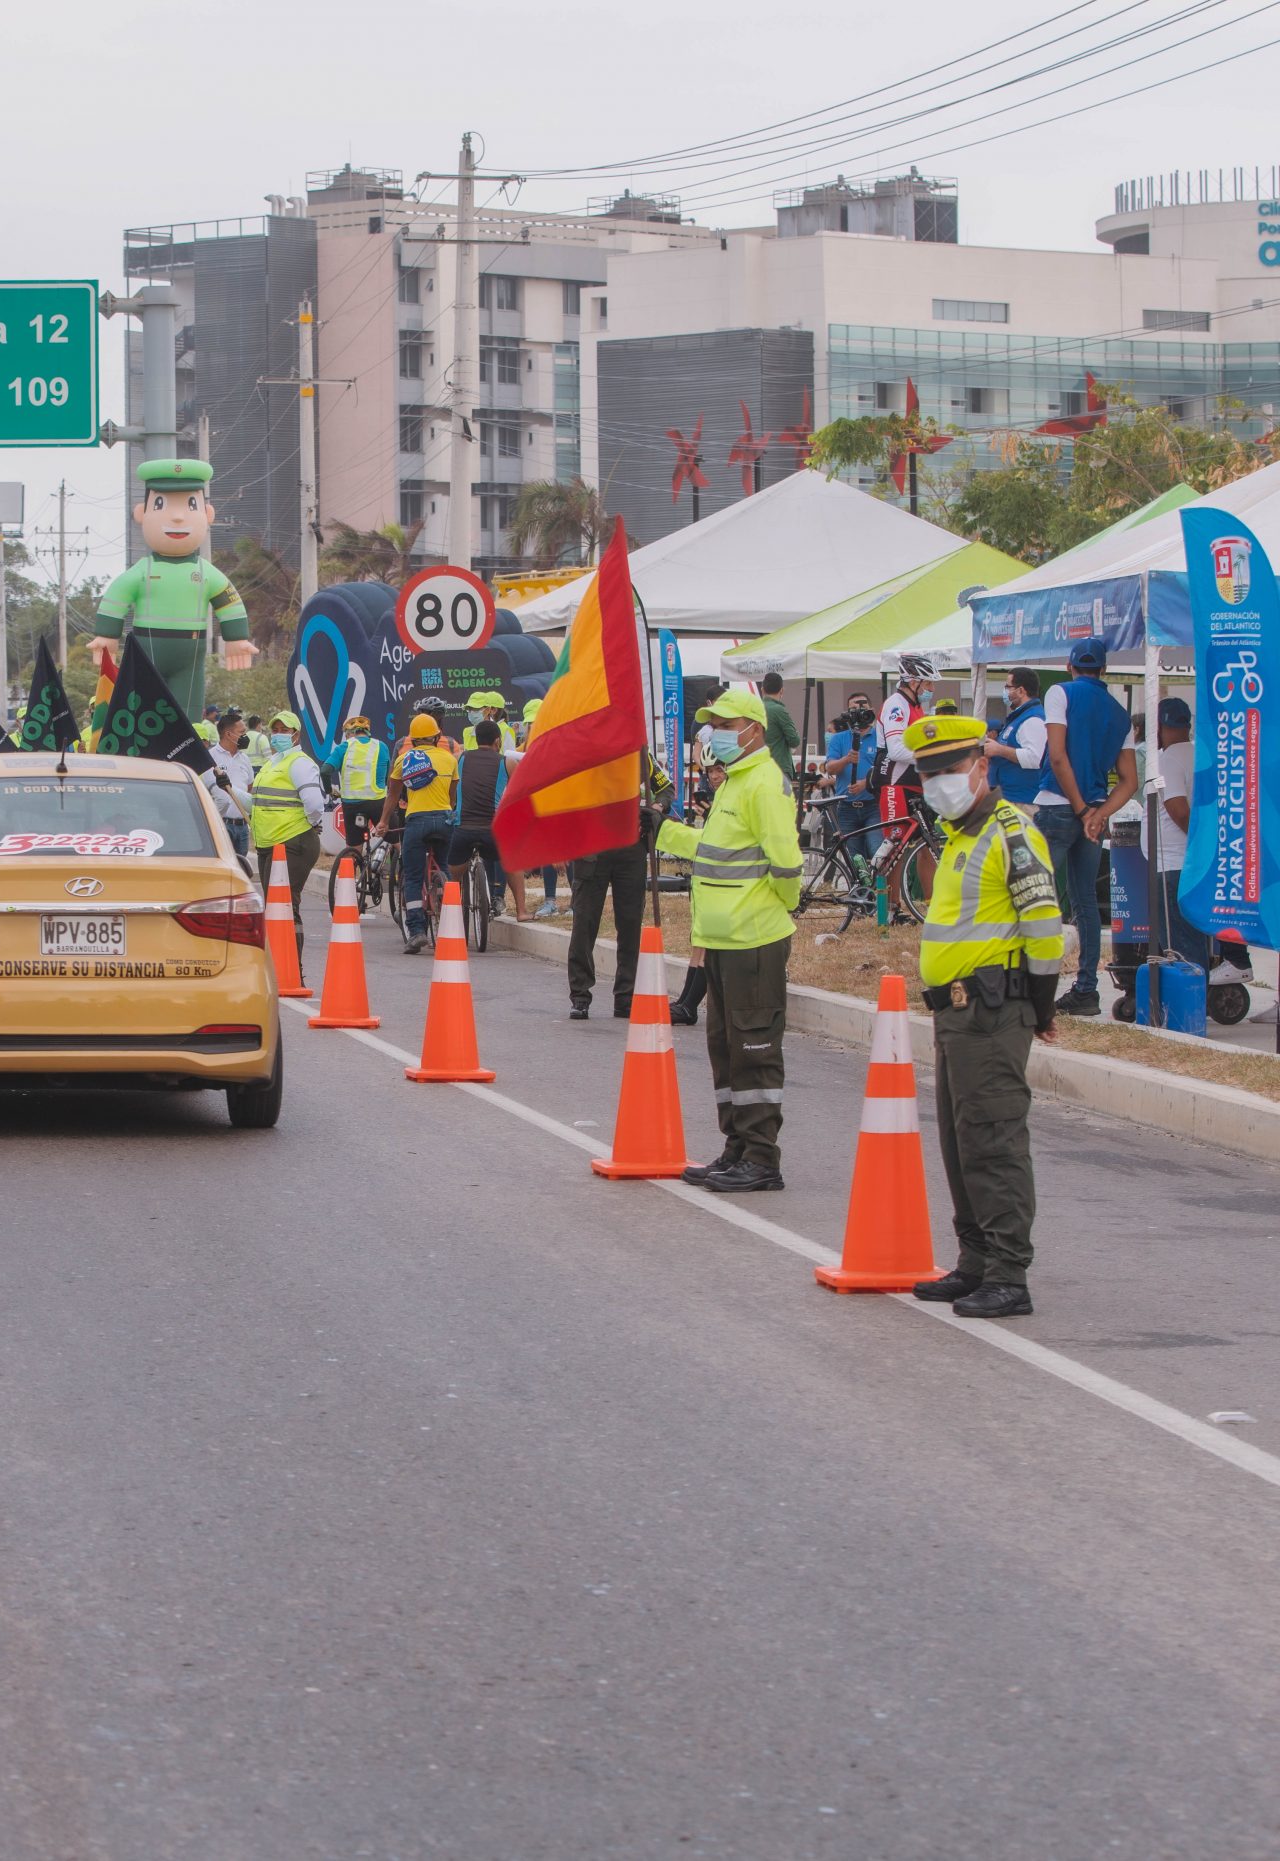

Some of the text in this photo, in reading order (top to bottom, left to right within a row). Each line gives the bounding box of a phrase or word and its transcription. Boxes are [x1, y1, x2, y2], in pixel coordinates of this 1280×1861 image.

[28, 314, 69, 344] 12
[7, 376, 69, 407] 109
[415, 593, 478, 637] 80
[1210, 610, 1260, 620] GOBERNACIÓN
[1211, 622, 1223, 631] DEL
[446, 668, 486, 678] TODOS
[448, 677, 502, 688] CABEMOS
[1249, 712, 1258, 743] seguro.
[1249, 745, 1257, 783] muévete
[4, 786, 19, 794] IN
[53, 785, 75, 793] WE
[79, 786, 125, 794] TRUST
[1215, 711, 1229, 900] PUNTOS SEGUROS
[1230, 711, 1245, 900] PARA CICLISTAS
[1249, 802, 1257, 810] la
[1250, 812, 1257, 823] en
[1249, 824, 1257, 862] muévete
[1248, 864, 1257, 899] Ciclista,
[1013, 885, 1055, 908] TRANSPORTE
[72, 961, 89, 976] SU
[94, 961, 166, 978] DISTANCIA
[175, 966, 212, 977] 80 Km
